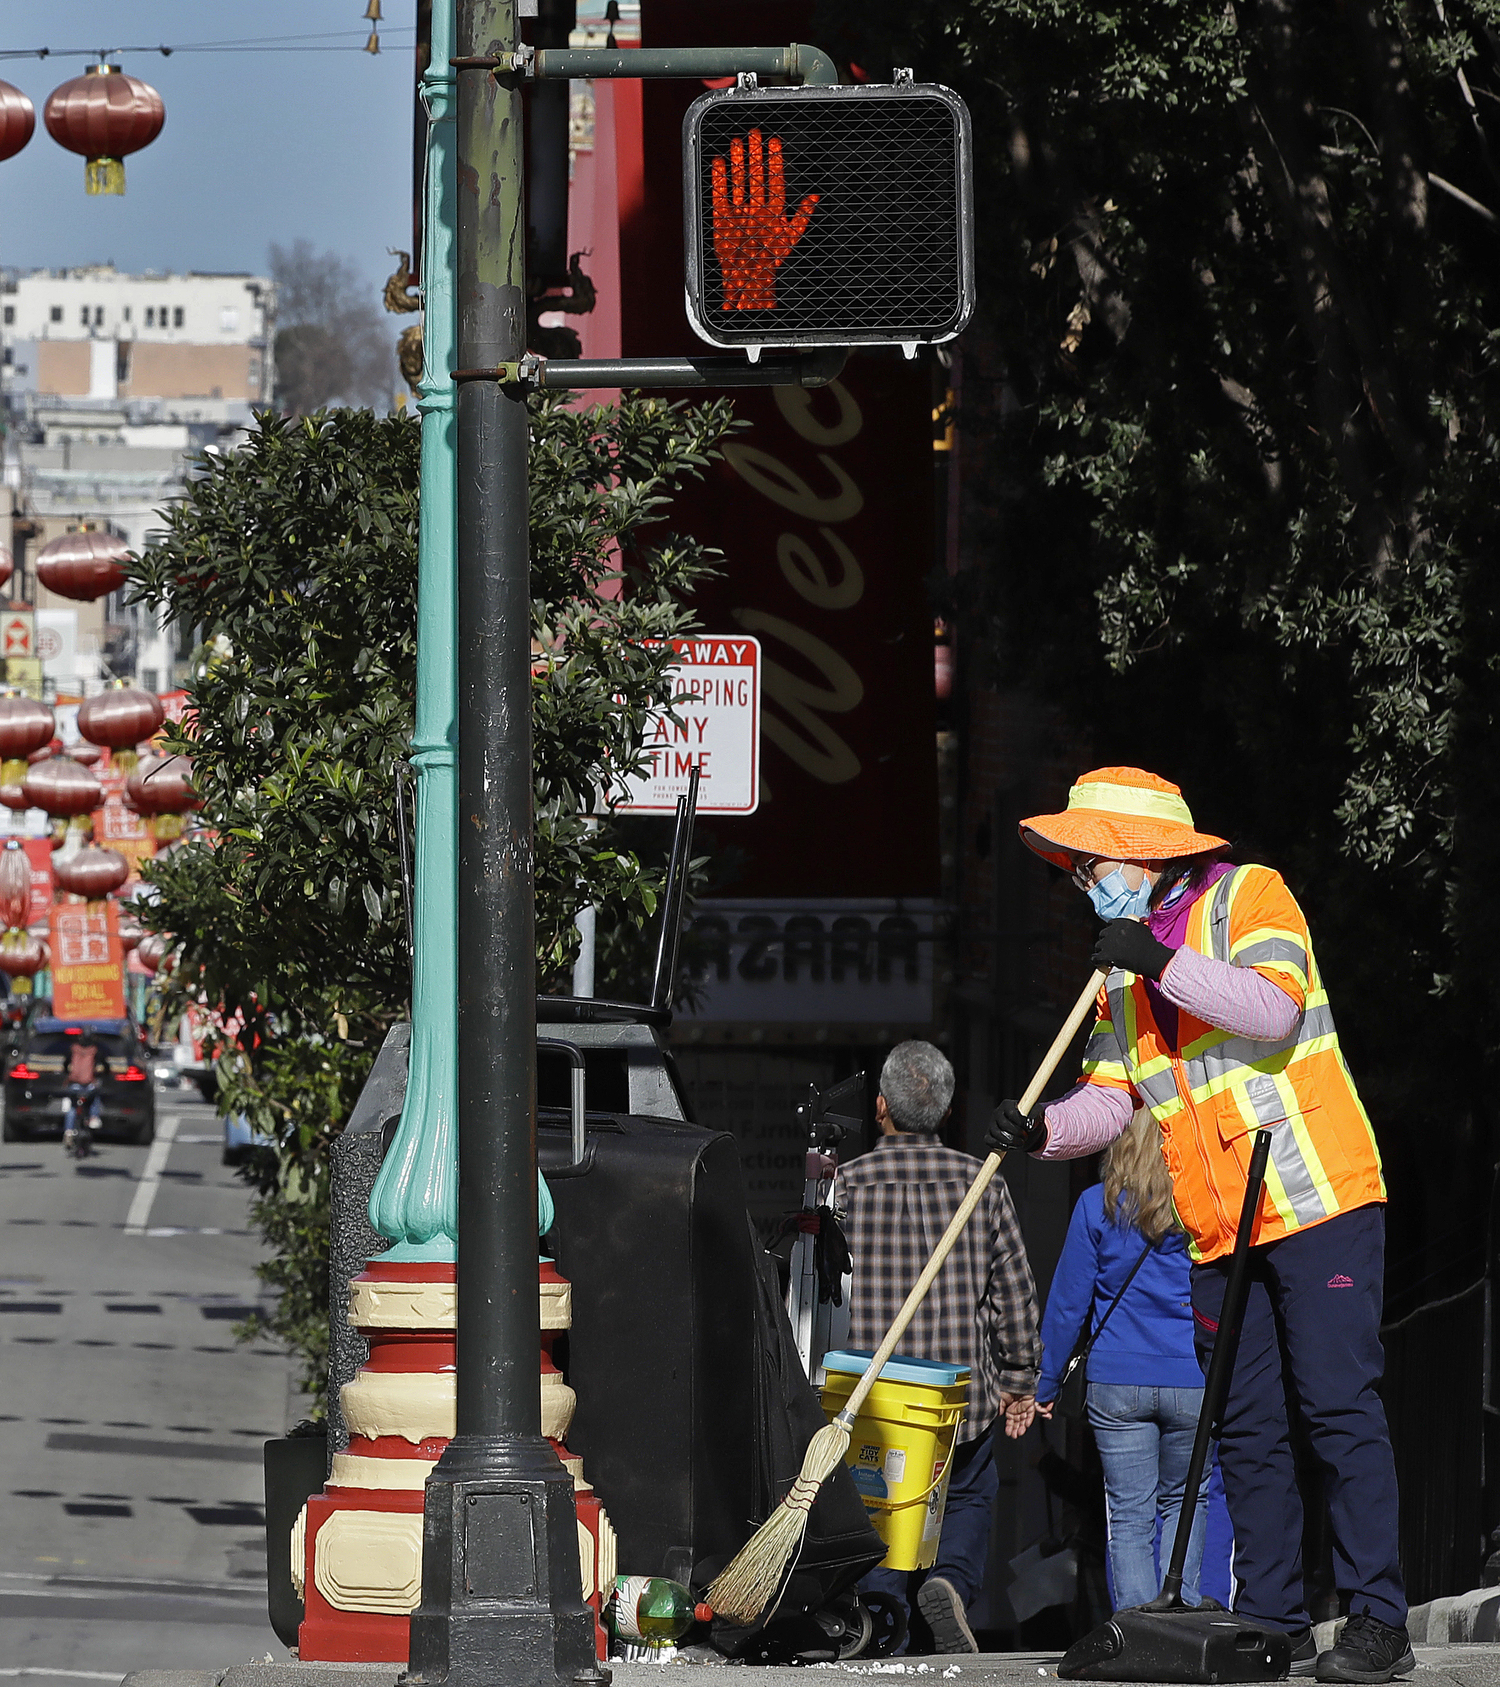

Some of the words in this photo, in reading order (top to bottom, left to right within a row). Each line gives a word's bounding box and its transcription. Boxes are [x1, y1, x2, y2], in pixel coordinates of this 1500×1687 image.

[679, 643, 747, 664] AWAY
[653, 716, 709, 744] ANY
[648, 751, 712, 778] TIME
[741, 1150, 803, 1170] ction
[859, 1454, 879, 1463] CATS
[860, 1448, 879, 1456] TIDY
